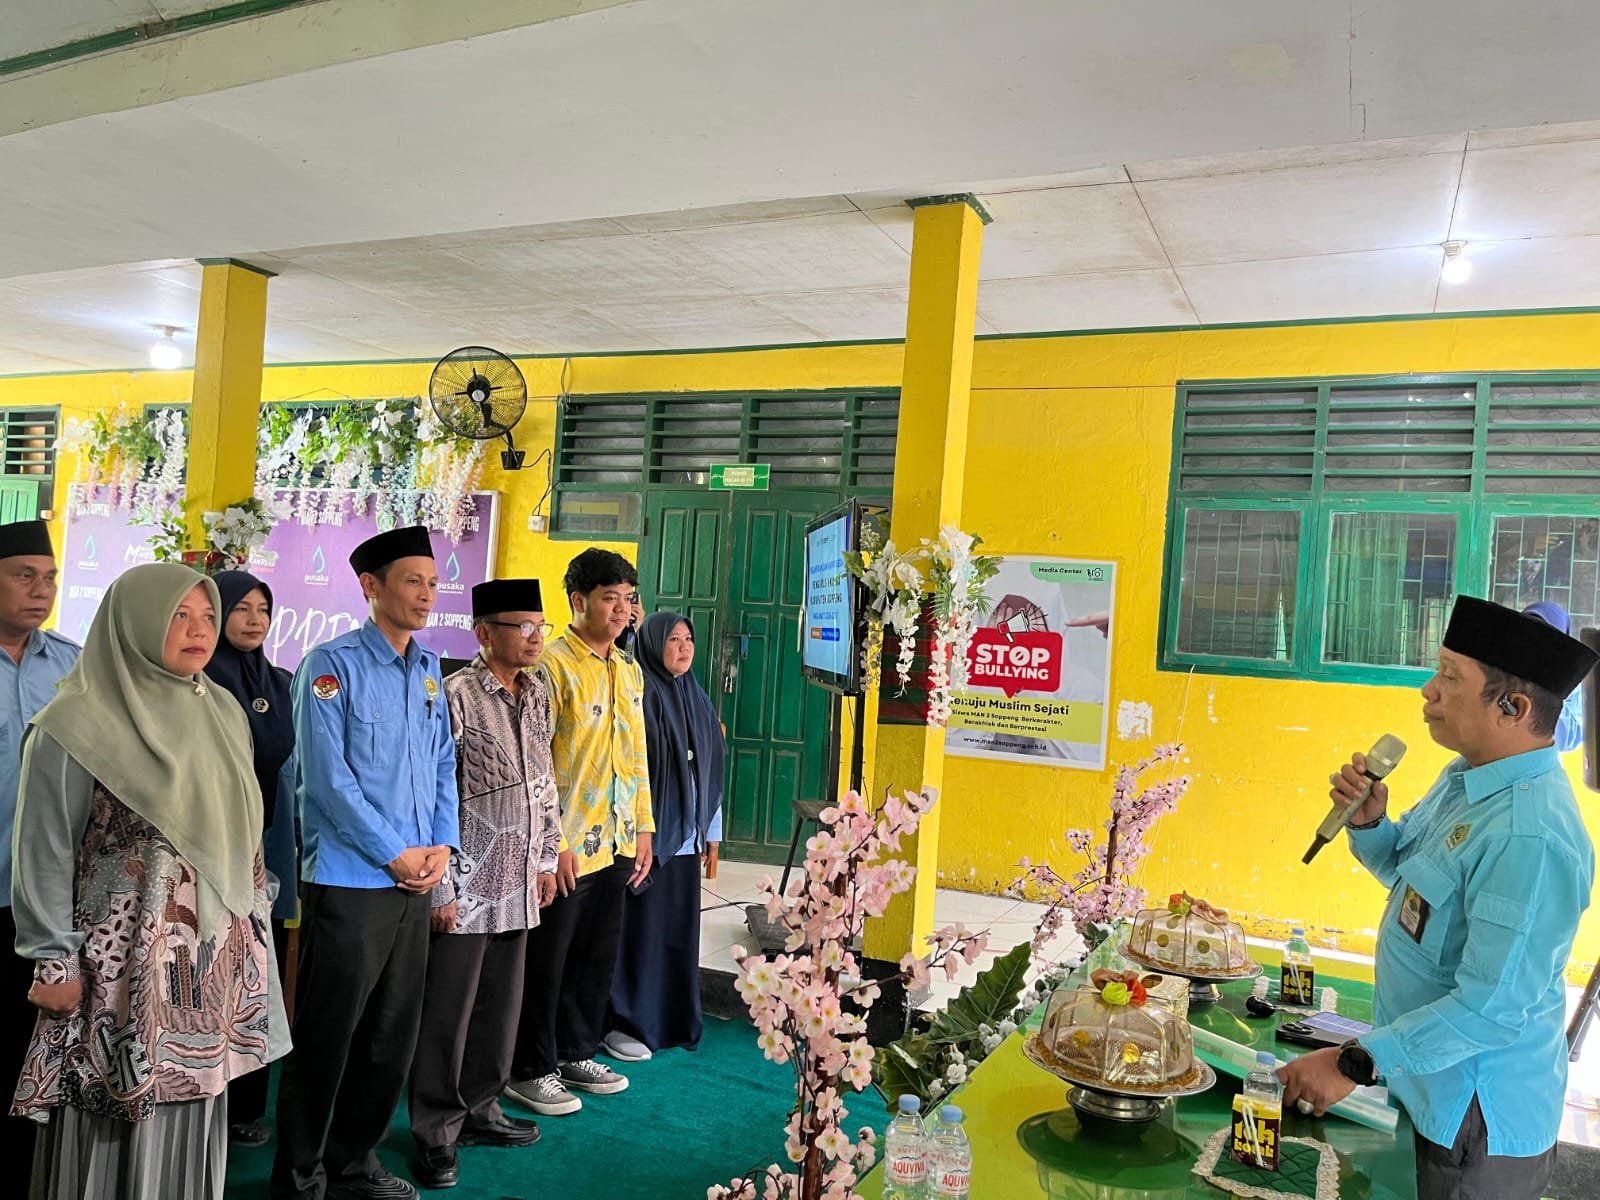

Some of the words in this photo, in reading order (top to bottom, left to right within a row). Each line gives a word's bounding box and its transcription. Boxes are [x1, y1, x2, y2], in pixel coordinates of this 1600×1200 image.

[304, 574, 329, 582] pusaka
[437, 582, 465, 591] pusaka
[439, 613, 443, 627] 2
[444, 613, 472, 631] SOPPENG
[975, 643, 1050, 667] STOP
[974, 664, 1049, 680] BULLYING
[950, 696, 986, 709] enuju
[989, 699, 1031, 711] Muslim
[1034, 703, 1069, 716] Sejati
[991, 714, 1019, 722] Soppeng
